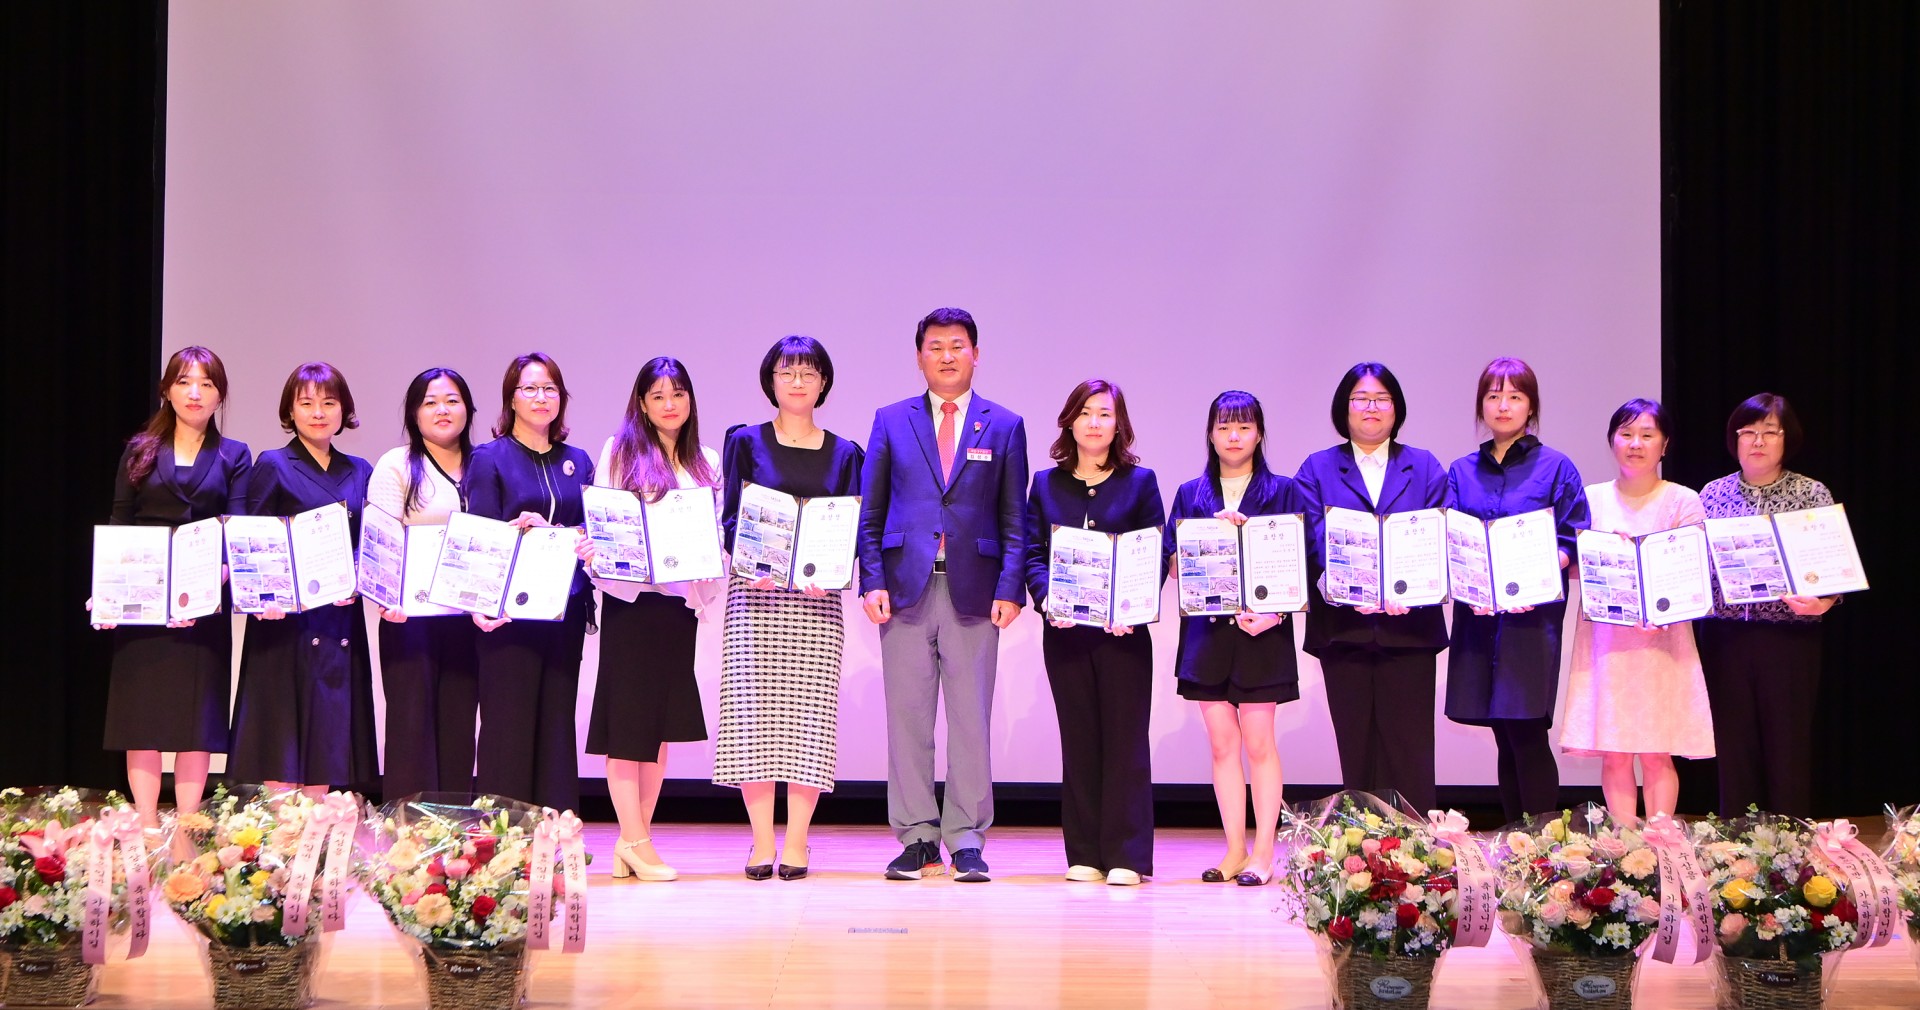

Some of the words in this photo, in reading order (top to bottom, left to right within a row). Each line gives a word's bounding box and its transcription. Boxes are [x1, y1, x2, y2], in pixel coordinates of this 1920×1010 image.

[127, 844, 144, 873] 수상을
[335, 830, 347, 856] 수상을
[567, 852, 582, 881] 수상을
[134, 884, 148, 941] 축하합니다
[288, 873, 306, 923] 가득하시길
[327, 866, 341, 922] 축하합니다
[1461, 885, 1475, 933] 가득하시길
[1469, 846, 1487, 872] 수상을
[1479, 881, 1492, 933] 축하합니다
[1678, 852, 1697, 881] 수상을
[1693, 891, 1710, 945] 축하합니다
[1859, 890, 1871, 940] 가득하시길
[1861, 851, 1883, 875] 수상을
[1878, 885, 1892, 938] 축하합니다
[88, 895, 105, 948] 가득하시길
[532, 891, 547, 940] 가득하시길
[568, 892, 583, 943] 축하합니다
[1661, 893, 1677, 945] 가득하시길
